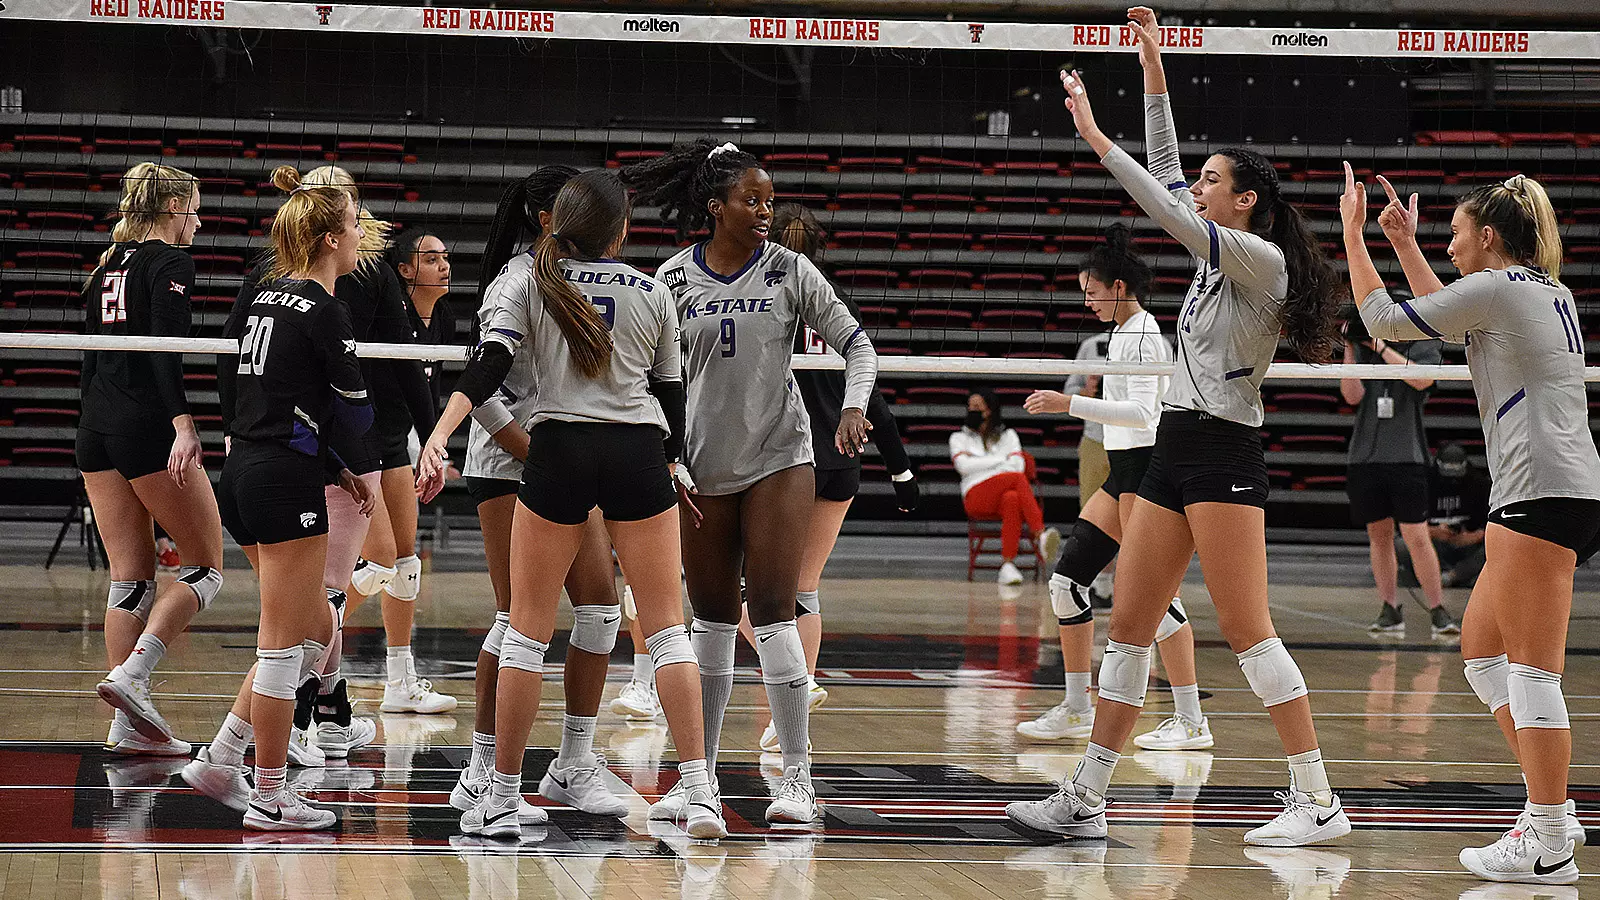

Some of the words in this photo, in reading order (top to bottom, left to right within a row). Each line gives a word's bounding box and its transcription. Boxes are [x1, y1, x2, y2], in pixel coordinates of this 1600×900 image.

[90, 0, 129, 17] RED
[137, 0, 225, 20] RAIDERS
[422, 8, 461, 29] RED
[469, 10, 554, 32] RAIDERS
[623, 17, 680, 33] molten
[749, 18, 787, 38] RED
[795, 19, 880, 41] RAIDERS
[1073, 25, 1111, 46] RED
[1271, 32, 1329, 47] molten
[1397, 31, 1435, 51] RED
[1443, 31, 1529, 53] RAIDERS
[666, 269, 686, 287] BLM
[101, 269, 129, 324] 21
[686, 297, 774, 320] K-STATE
[720, 317, 737, 358] 9
[1552, 297, 1584, 355] 11
[237, 315, 275, 376] 20
